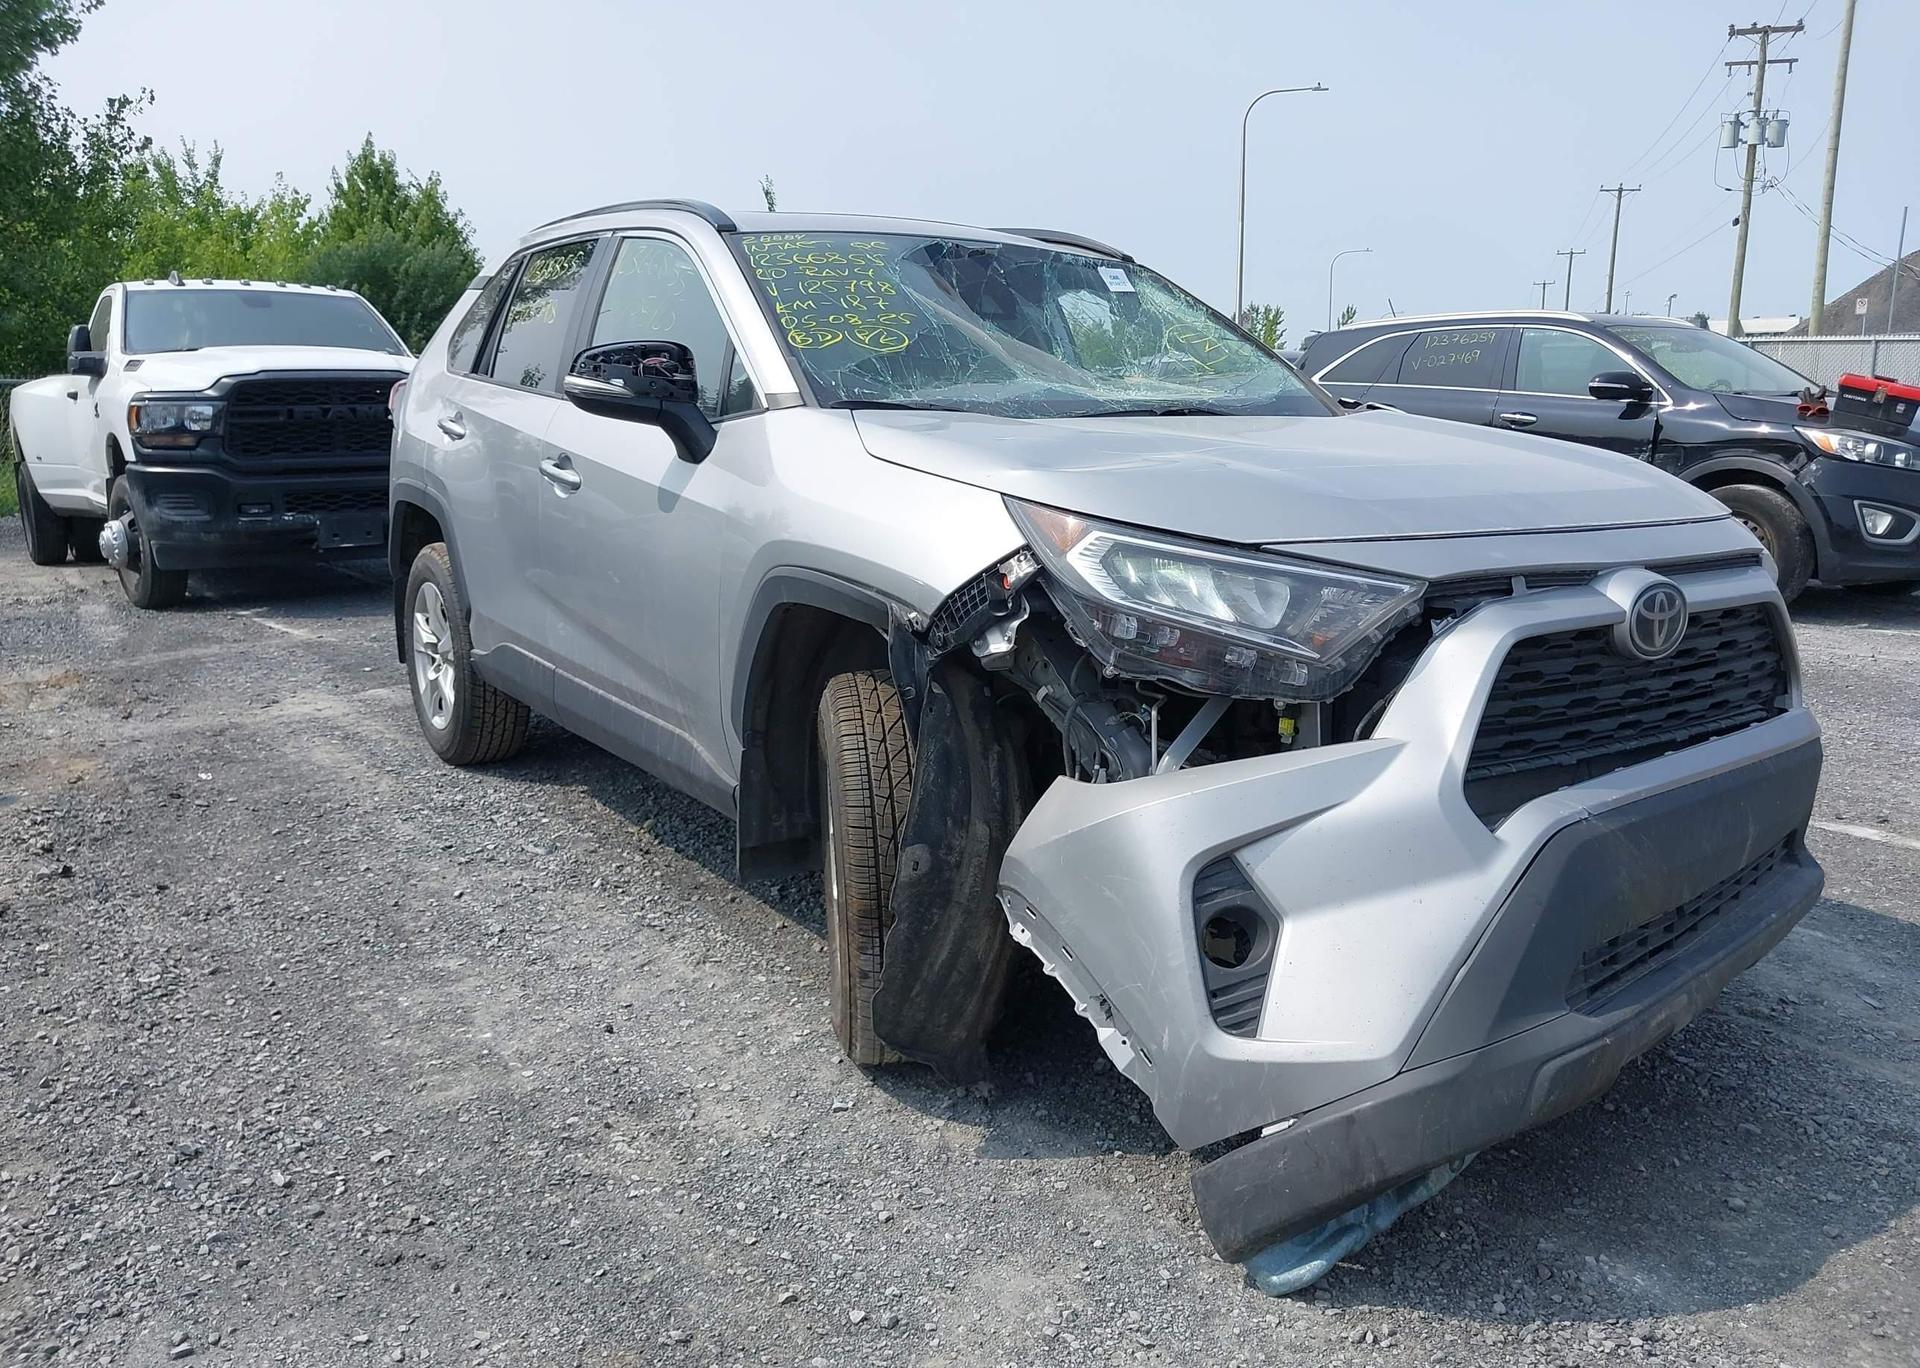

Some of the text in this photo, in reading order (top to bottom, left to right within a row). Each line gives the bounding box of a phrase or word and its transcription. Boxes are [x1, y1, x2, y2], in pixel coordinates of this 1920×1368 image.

[750, 252, 885, 268] 12366855
[1425, 331, 1496, 349] 12376259
[1412, 349, 1480, 370] V-027469
[294, 404, 385, 420] RAM
